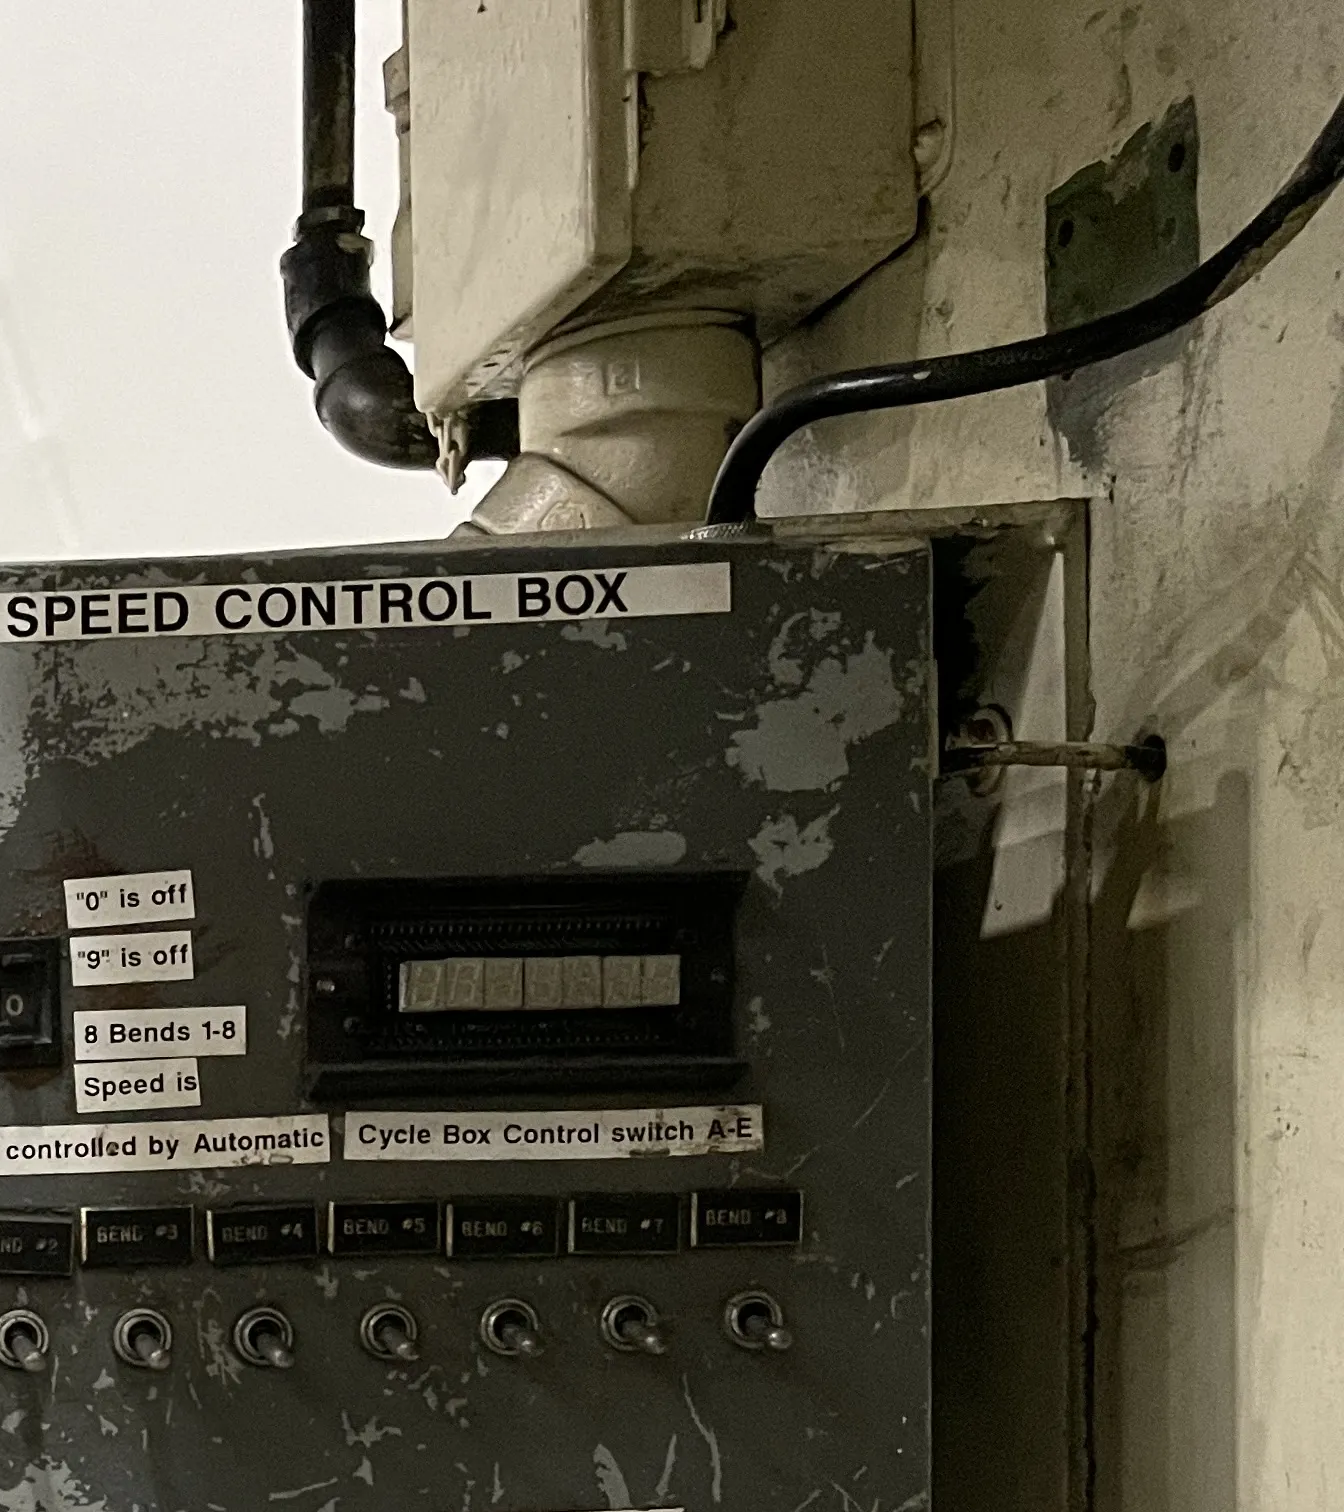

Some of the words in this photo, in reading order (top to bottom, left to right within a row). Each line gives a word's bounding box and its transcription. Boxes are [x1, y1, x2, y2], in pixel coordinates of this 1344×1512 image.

[5, 592, 190, 638] SPEED
[214, 578, 493, 632] CONTROL
[516, 572, 629, 619] BOX
[120, 887, 141, 908] is
[151, 883, 188, 906] off
[120, 947, 142, 968] is
[152, 944, 189, 965] off
[84, 1024, 98, 1043] 8
[110, 1022, 191, 1043] Bends
[202, 1020, 236, 1041] 1-8
[83, 1073, 164, 1101] Speed
[176, 1073, 198, 1092] is
[6, 1136, 137, 1161] controlled
[148, 1135, 180, 1160] by
[194, 1128, 325, 1154] Automatic
[358, 1123, 432, 1150] Cycle
[443, 1123, 492, 1145] Box
[503, 1122, 600, 1145] Control
[611, 1120, 695, 1143] switch
[707, 1117, 753, 1140] A-E
[343, 1218, 390, 1235] BEND
